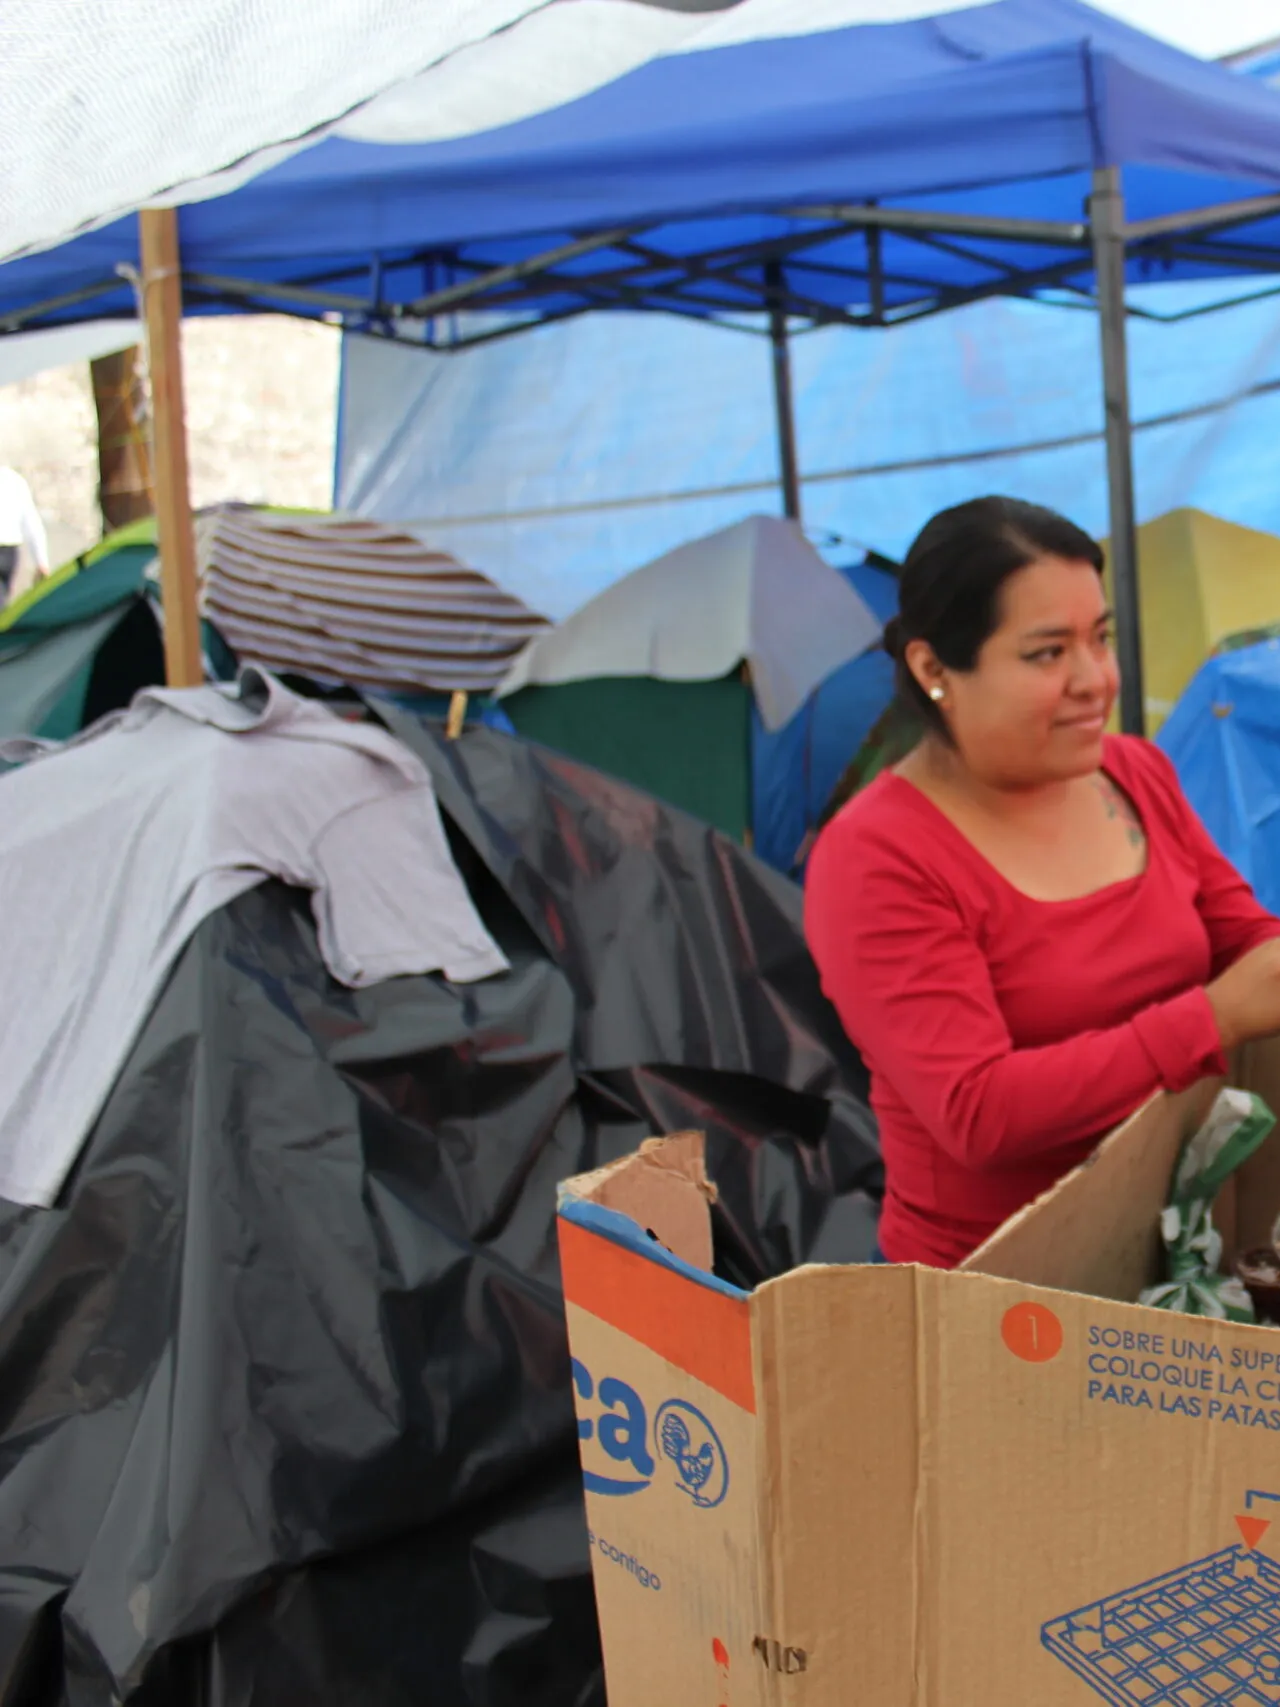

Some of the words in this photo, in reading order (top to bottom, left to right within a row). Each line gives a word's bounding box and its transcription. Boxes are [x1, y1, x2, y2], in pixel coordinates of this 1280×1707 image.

[1027, 1314, 1038, 1350] 1
[1088, 1325, 1164, 1355] SOBRE
[1170, 1338, 1223, 1364] UNA
[1087, 1353, 1213, 1391] COLOQUE
[1218, 1374, 1249, 1397] LA
[1087, 1380, 1152, 1410] PARA
[1160, 1392, 1201, 1418] LAS
[599, 1539, 661, 1591] contigo
